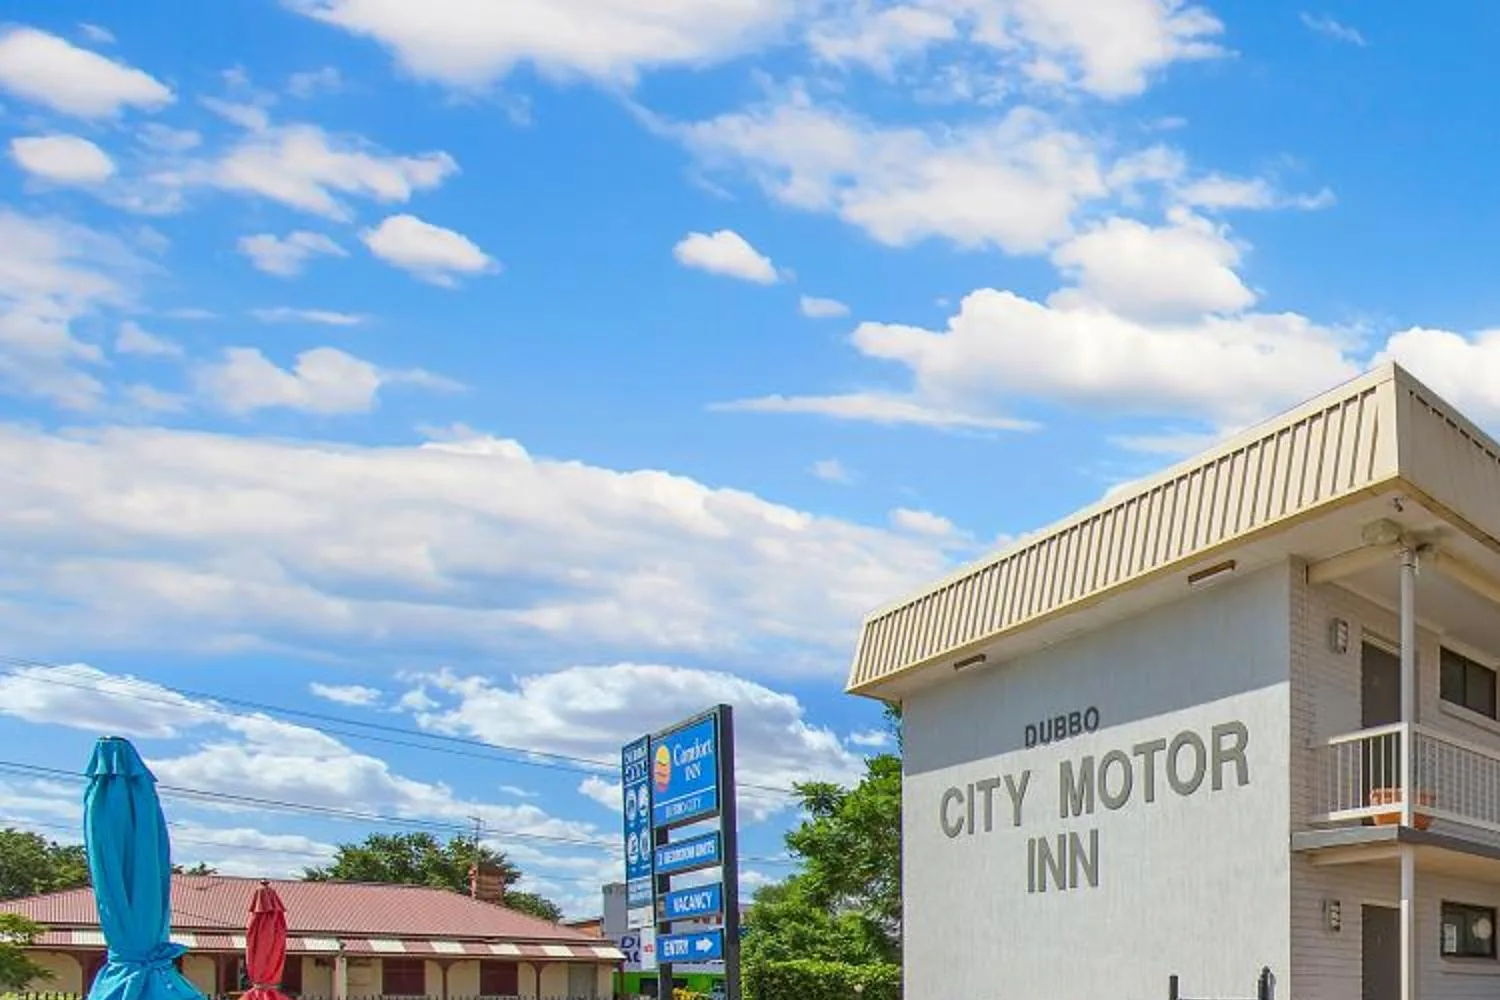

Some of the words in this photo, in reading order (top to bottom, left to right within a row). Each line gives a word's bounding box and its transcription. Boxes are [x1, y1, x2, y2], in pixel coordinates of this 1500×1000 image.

[1024, 706, 1100, 748] DUBBO
[673, 738, 713, 767] Comfort
[684, 762, 702, 782] INN
[939, 769, 1031, 838] CITY
[1059, 720, 1249, 819] MOTOR
[1027, 829, 1099, 893] INN
[673, 891, 713, 912] VACANCY
[663, 938, 689, 957] ENTRY
